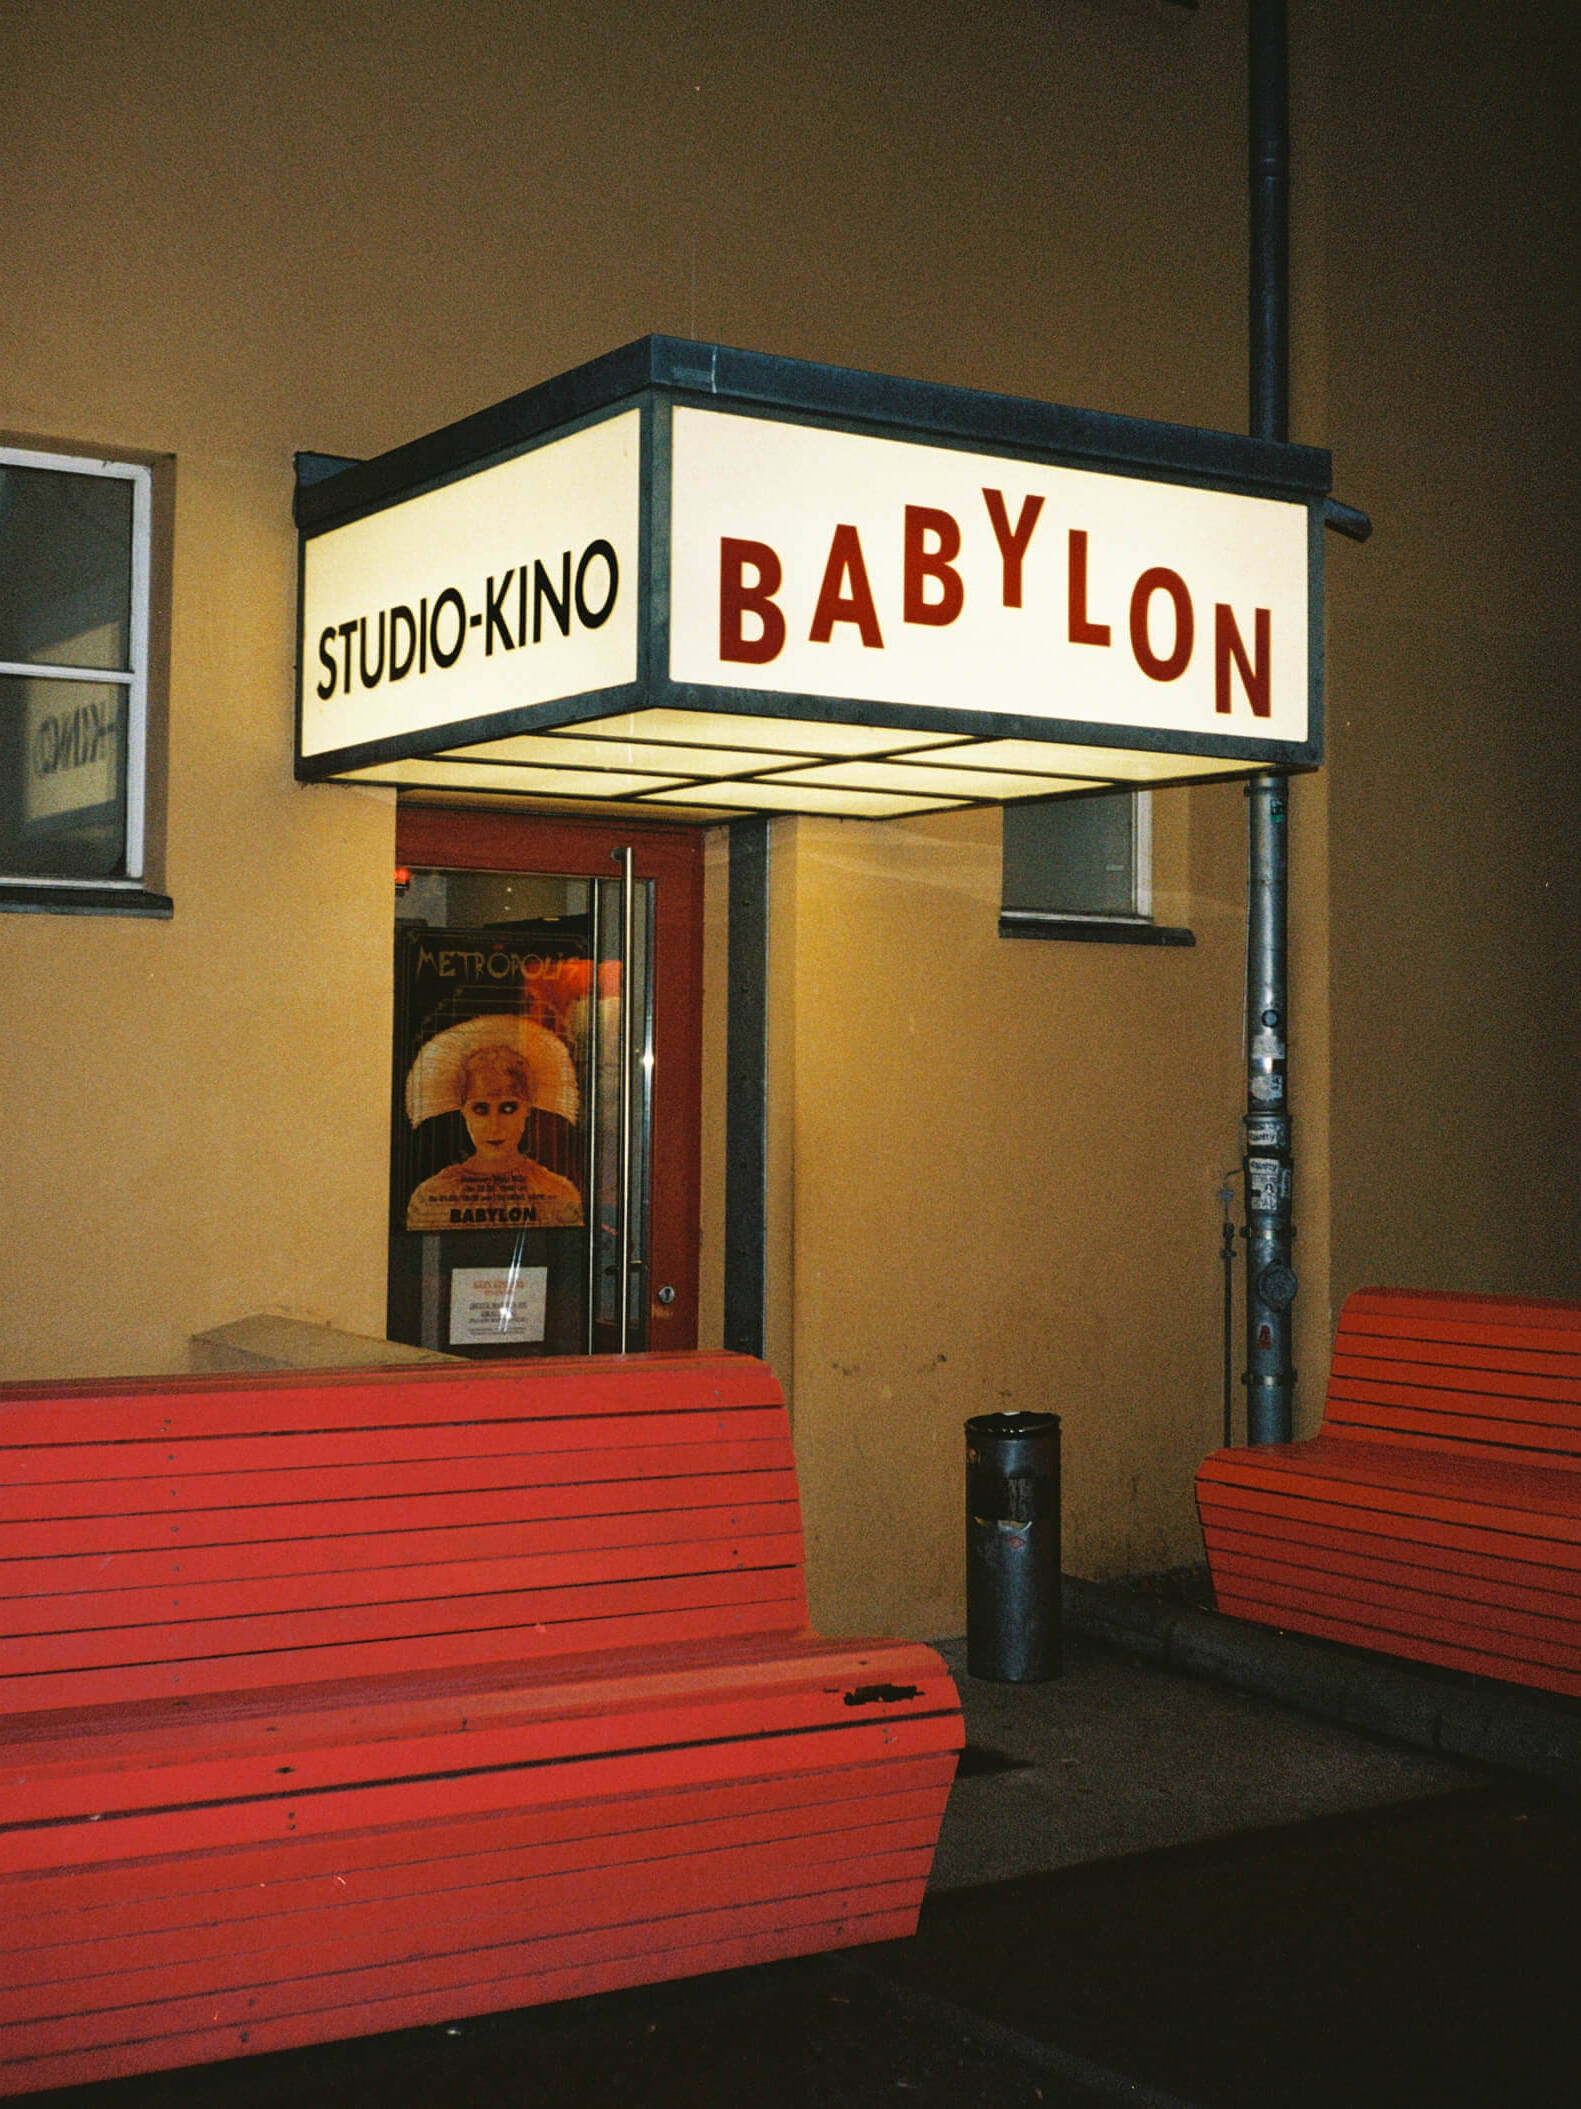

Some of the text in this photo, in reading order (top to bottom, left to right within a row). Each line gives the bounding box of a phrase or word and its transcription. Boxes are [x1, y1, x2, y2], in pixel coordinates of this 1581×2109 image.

[318, 539, 620, 701] STUDIO-KINO
[720, 488, 1272, 718] BABYLON
[449, 1207, 537, 1223] BABYLON
